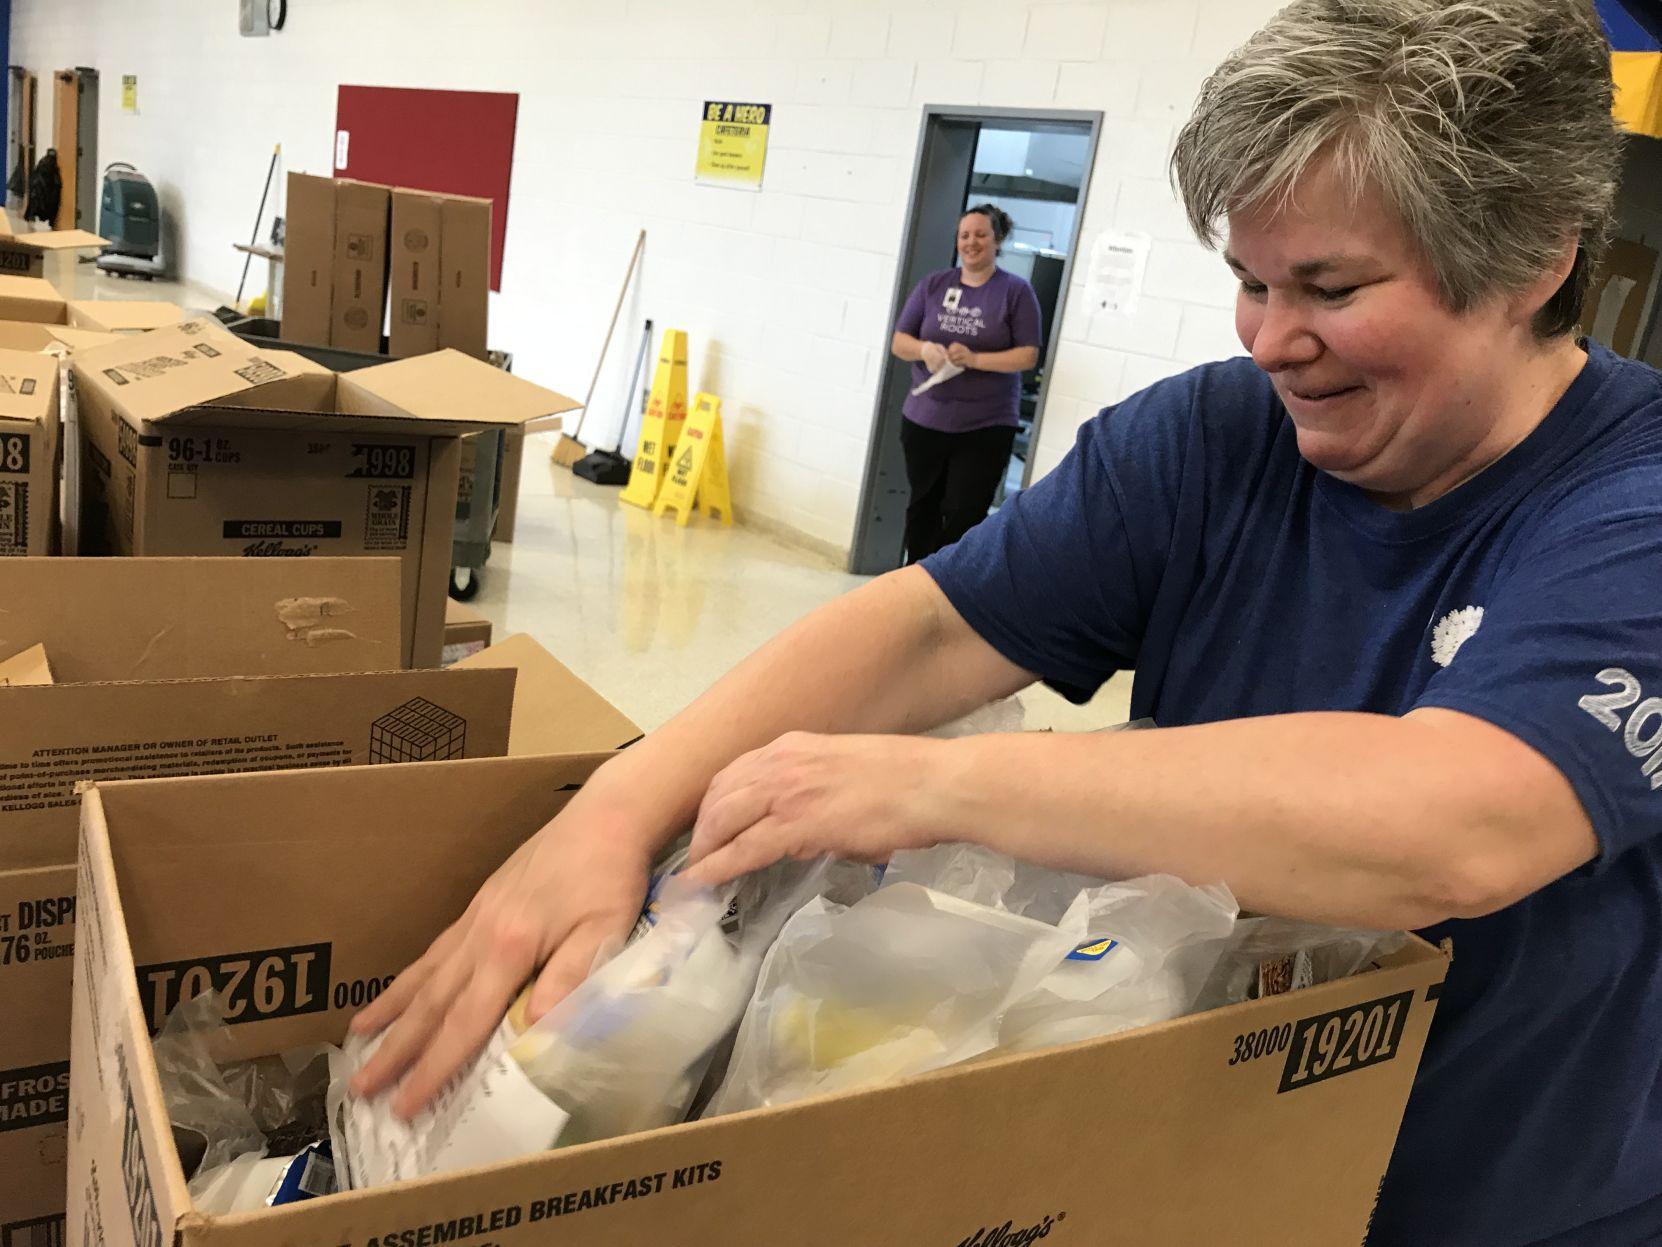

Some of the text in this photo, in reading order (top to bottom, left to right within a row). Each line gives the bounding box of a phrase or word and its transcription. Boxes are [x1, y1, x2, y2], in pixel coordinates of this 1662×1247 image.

[706, 103, 766, 124] BE A HERO
[937, 313, 986, 329] VERTICAL
[940, 323, 978, 336] ROOTS
[0, 437, 23, 470] 8
[168, 438, 212, 462] 96-1
[242, 523, 324, 536] CEREAL CUPS
[32, 734, 278, 758] ATTENTION MANAGER OR OWNER OF RETAIL OUTLET
[32, 759, 51, 768] time
[2, 803, 45, 812] KELLOGG
[47, 800, 78, 808] SALES
[35, 932, 51, 945] OZ.
[1229, 1000, 1400, 1083] 38000 19201
[529, 1172, 667, 1222] BREAKFAST
[672, 1160, 722, 1189] KITS
